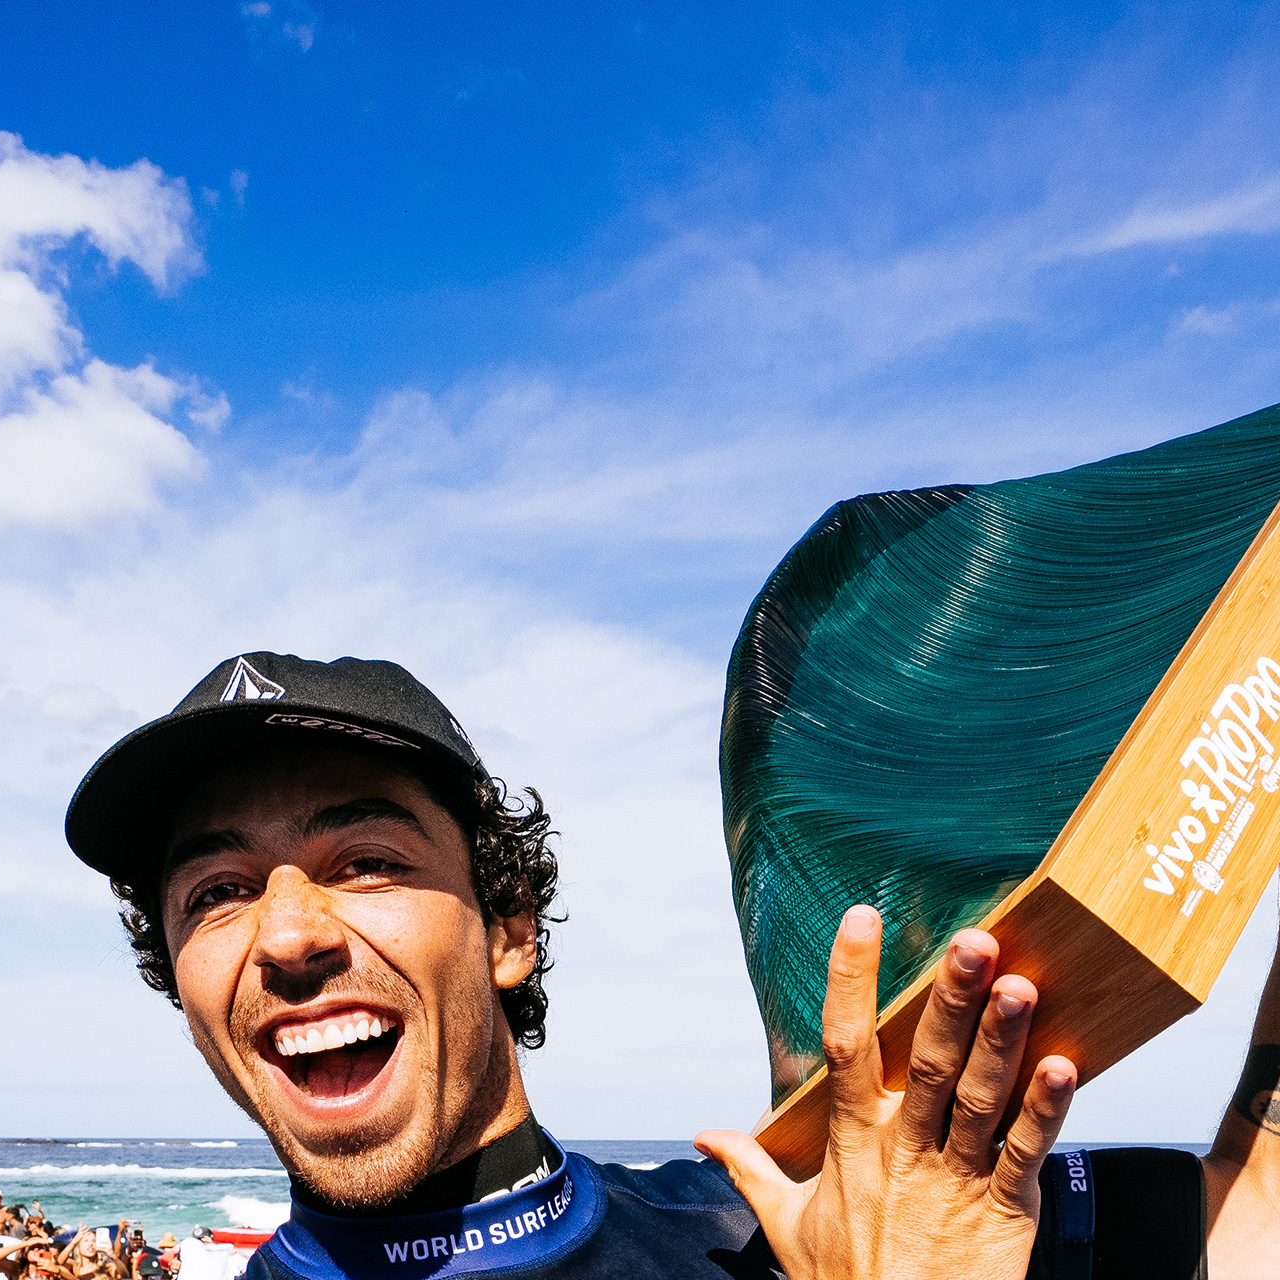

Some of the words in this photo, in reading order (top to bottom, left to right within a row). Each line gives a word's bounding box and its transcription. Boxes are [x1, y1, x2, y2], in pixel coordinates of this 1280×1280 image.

[1143, 815, 1207, 896] vivo
[1064, 1152, 1087, 1193] 2023
[383, 1228, 485, 1263] WORLD
[488, 1205, 548, 1245] SURF
